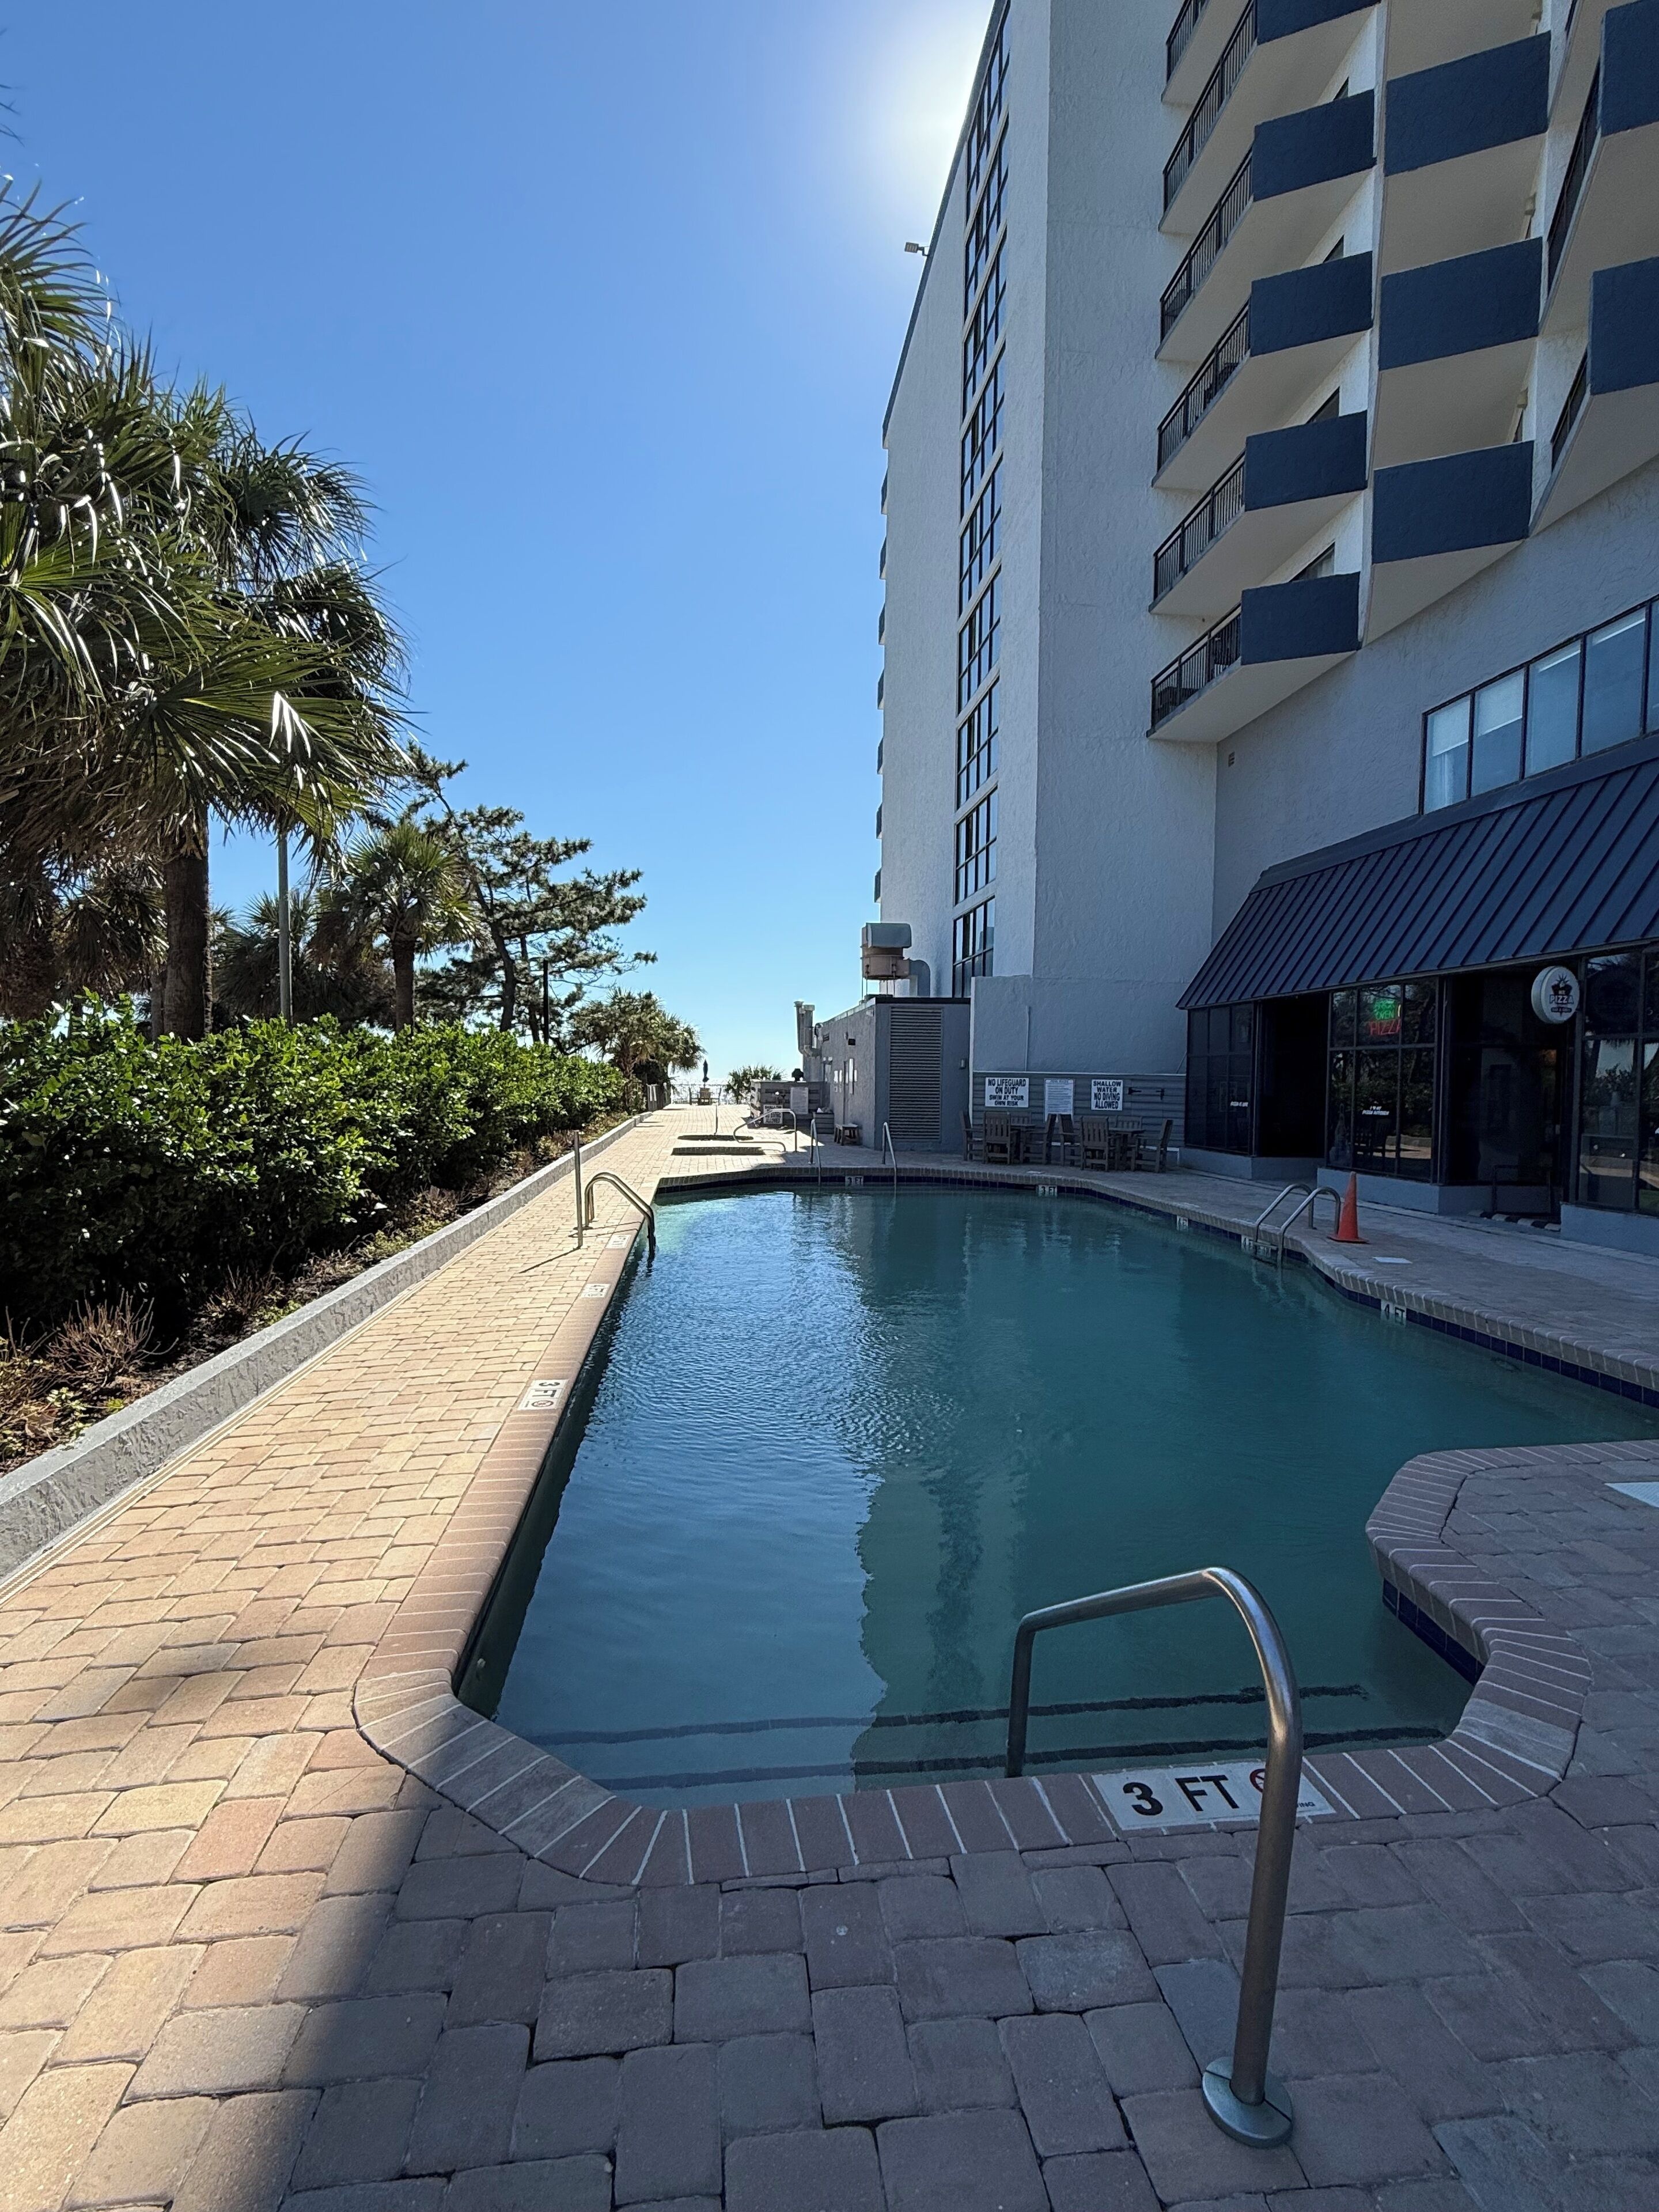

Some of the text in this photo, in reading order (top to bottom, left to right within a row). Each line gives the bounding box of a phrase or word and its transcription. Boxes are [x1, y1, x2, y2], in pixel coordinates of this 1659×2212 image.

[1550, 995, 1574, 1004] PIZZA
[1376, 1010, 1394, 1020] OVEN
[988, 1078, 995, 1086] NO
[1103, 1093, 1120, 1101] DIVING
[1095, 1101, 1119, 1109] ALLOWED
[1123, 1775, 1240, 1816] 3 FT
